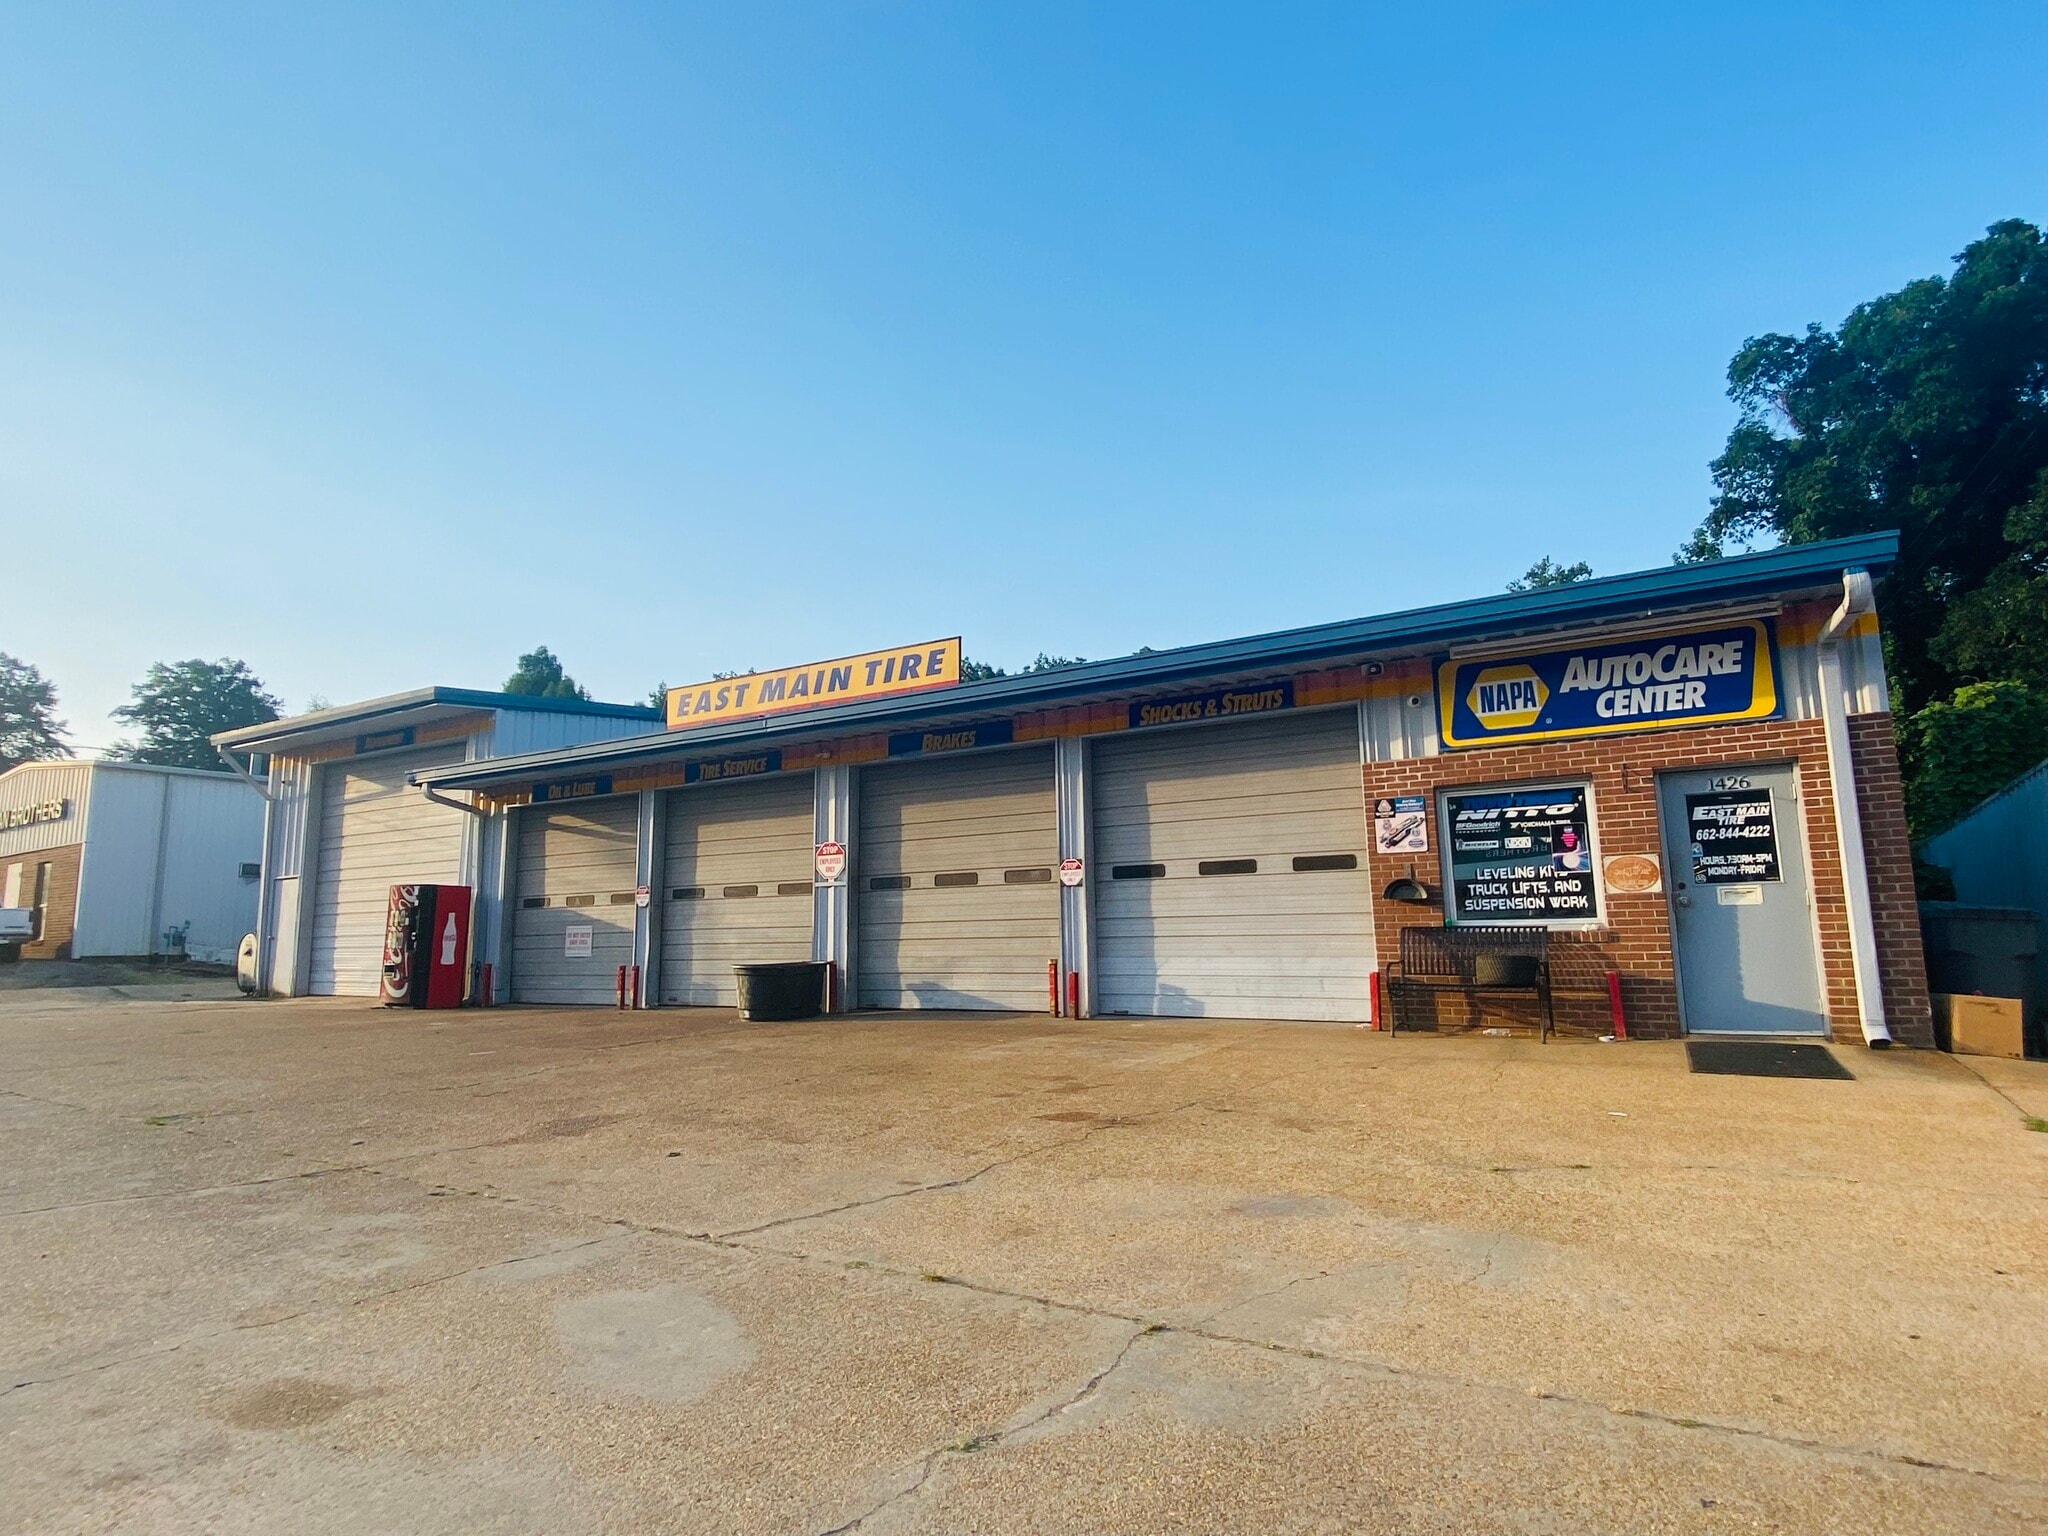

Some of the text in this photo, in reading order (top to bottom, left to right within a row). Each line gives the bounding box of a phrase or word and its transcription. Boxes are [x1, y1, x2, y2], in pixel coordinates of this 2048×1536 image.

[677, 648, 946, 717] EAST MAIN TIRE
[1479, 680, 1537, 714] NAPA
[1596, 681, 1706, 718] CENTER
[1140, 689, 1283, 726] SHOCKS & STRUTS
[922, 730, 976, 752] BRAKES
[701, 757, 768, 780] TIRE SERVICE
[1707, 776, 1750, 791] 1426
[9, 799, 62, 828] BROTHERS
[1456, 803, 1576, 821] NITTO
[1693, 806, 1734, 820] EAST
[1736, 805, 1770, 816] MAIN
[1717, 816, 1746, 826] TIRE
[1696, 825, 1770, 841] 662-844-4222
[822, 845, 838, 855] STOP
[1476, 864, 1568, 880] LEVELING KI
[1468, 883, 1508, 896] TRUCK
[1554, 879, 1582, 893] AND
[1465, 895, 1588, 911] SUSPENSION WORK
